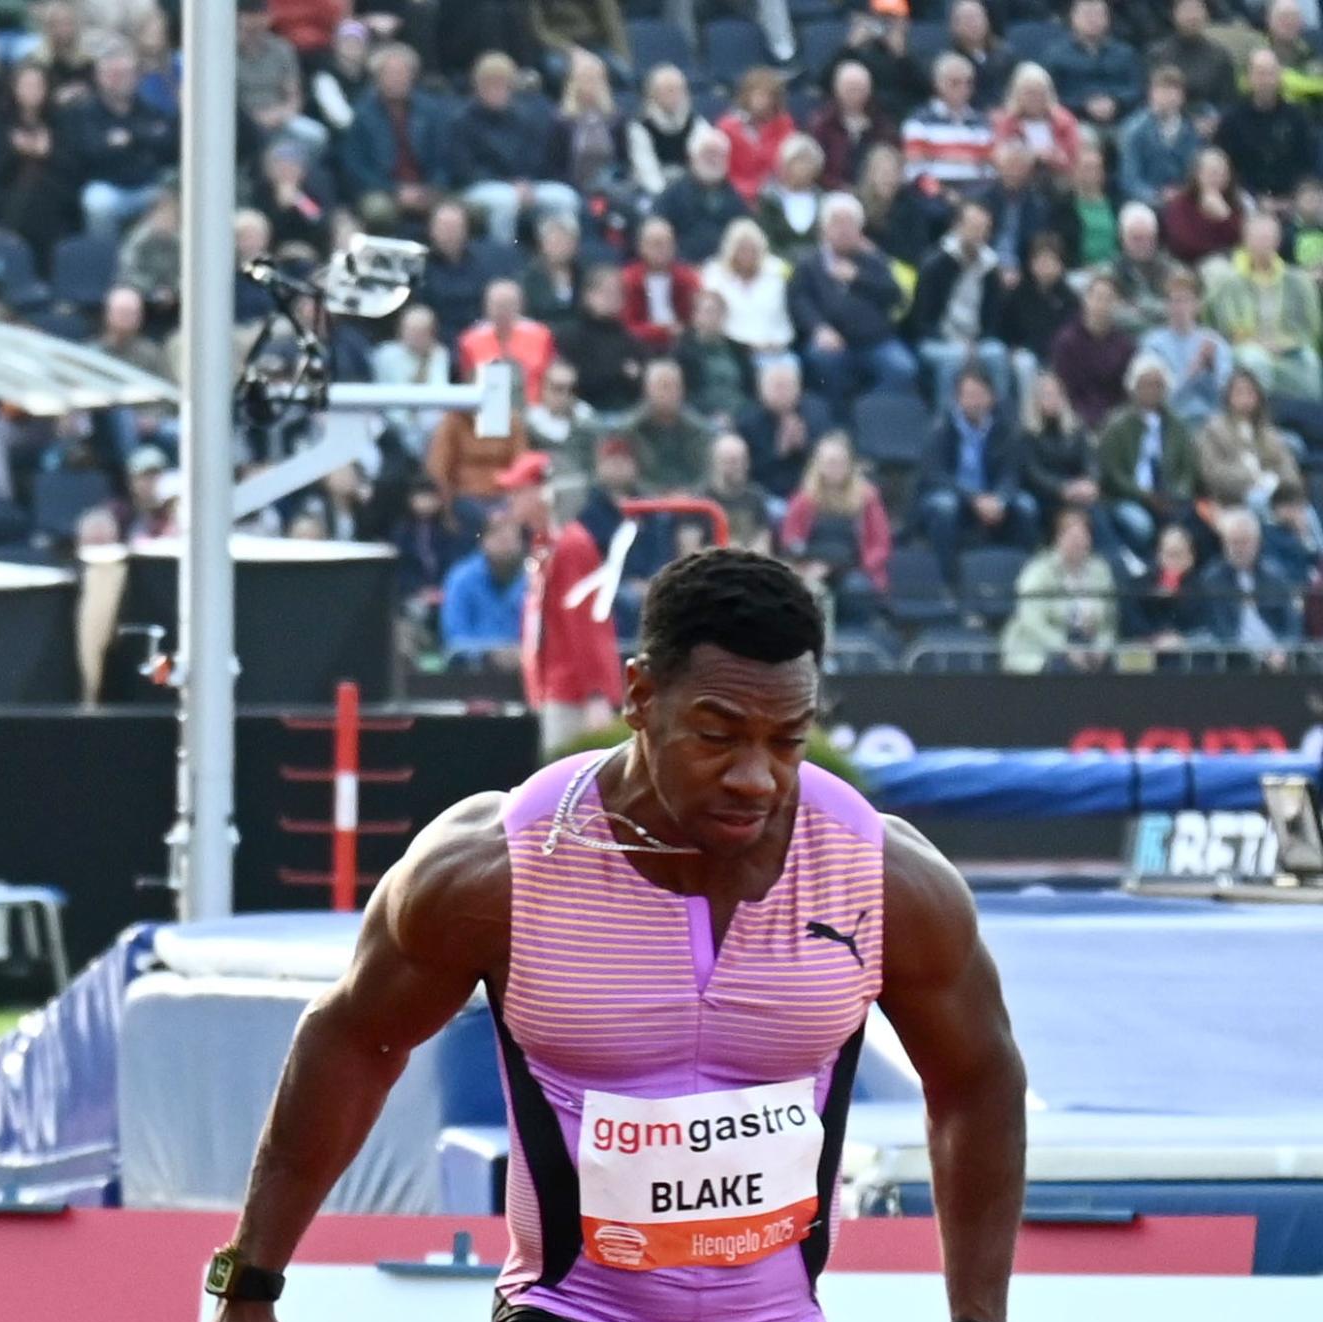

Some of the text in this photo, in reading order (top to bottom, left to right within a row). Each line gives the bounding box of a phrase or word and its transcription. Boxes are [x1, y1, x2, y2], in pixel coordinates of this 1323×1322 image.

[651, 1173, 763, 1213] BLAKE
[691, 1217, 795, 1262] Hengelo 2025
